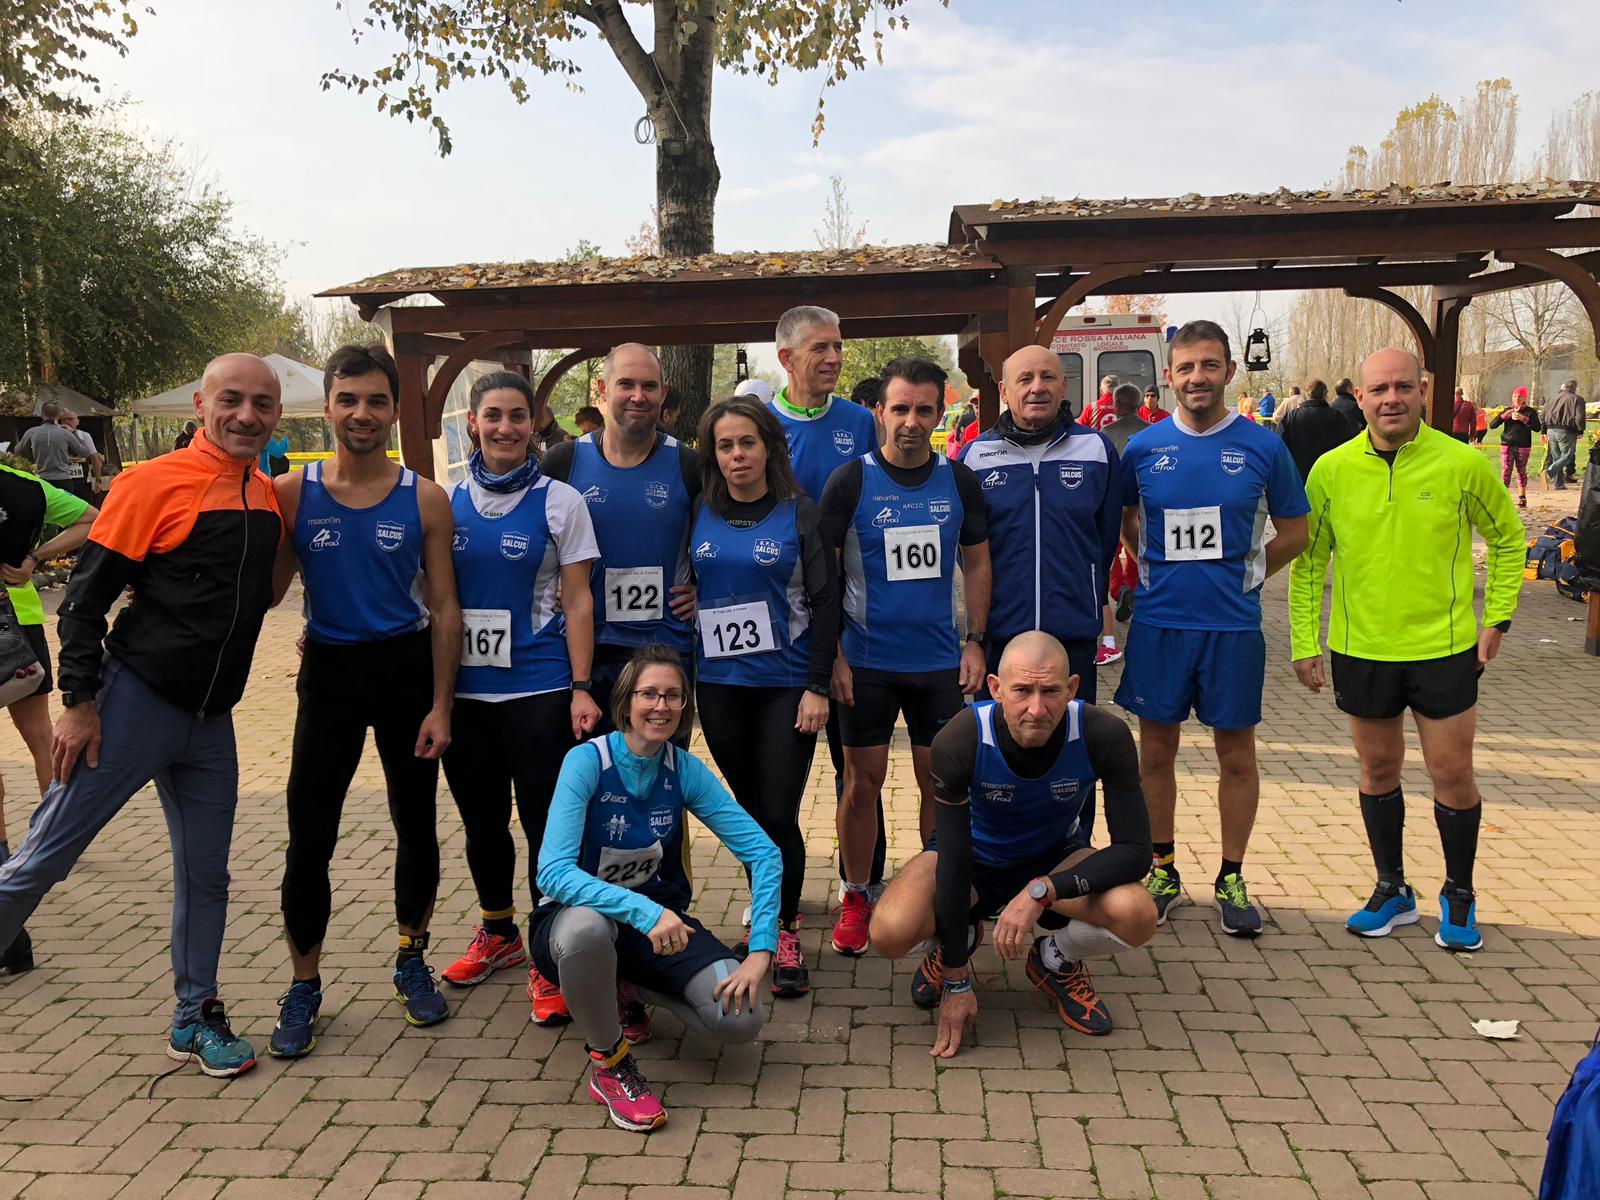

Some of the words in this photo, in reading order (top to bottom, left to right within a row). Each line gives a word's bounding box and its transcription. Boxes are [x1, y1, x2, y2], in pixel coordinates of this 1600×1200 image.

[1106, 333, 1147, 341] ITALIANA
[979, 449, 1008, 459] macron
[1151, 444, 1179, 454] macron
[1222, 455, 1245, 465] SALCUS
[1060, 471, 1082, 479] SALCUS
[929, 504, 951, 514] SALCUS
[307, 516, 341, 527] macron
[377, 529, 402, 541] SALCUS
[1171, 524, 1216, 550] 112
[502, 538, 527, 550] SALCUS
[754, 545, 780, 556] SALCUS
[891, 543, 937, 569] 160
[611, 585, 658, 610] 122
[713, 619, 760, 652] 123
[464, 627, 506, 656] 167
[981, 781, 1016, 790] macron
[650, 814, 673, 827] SALCUS
[604, 858, 655, 883] 224
